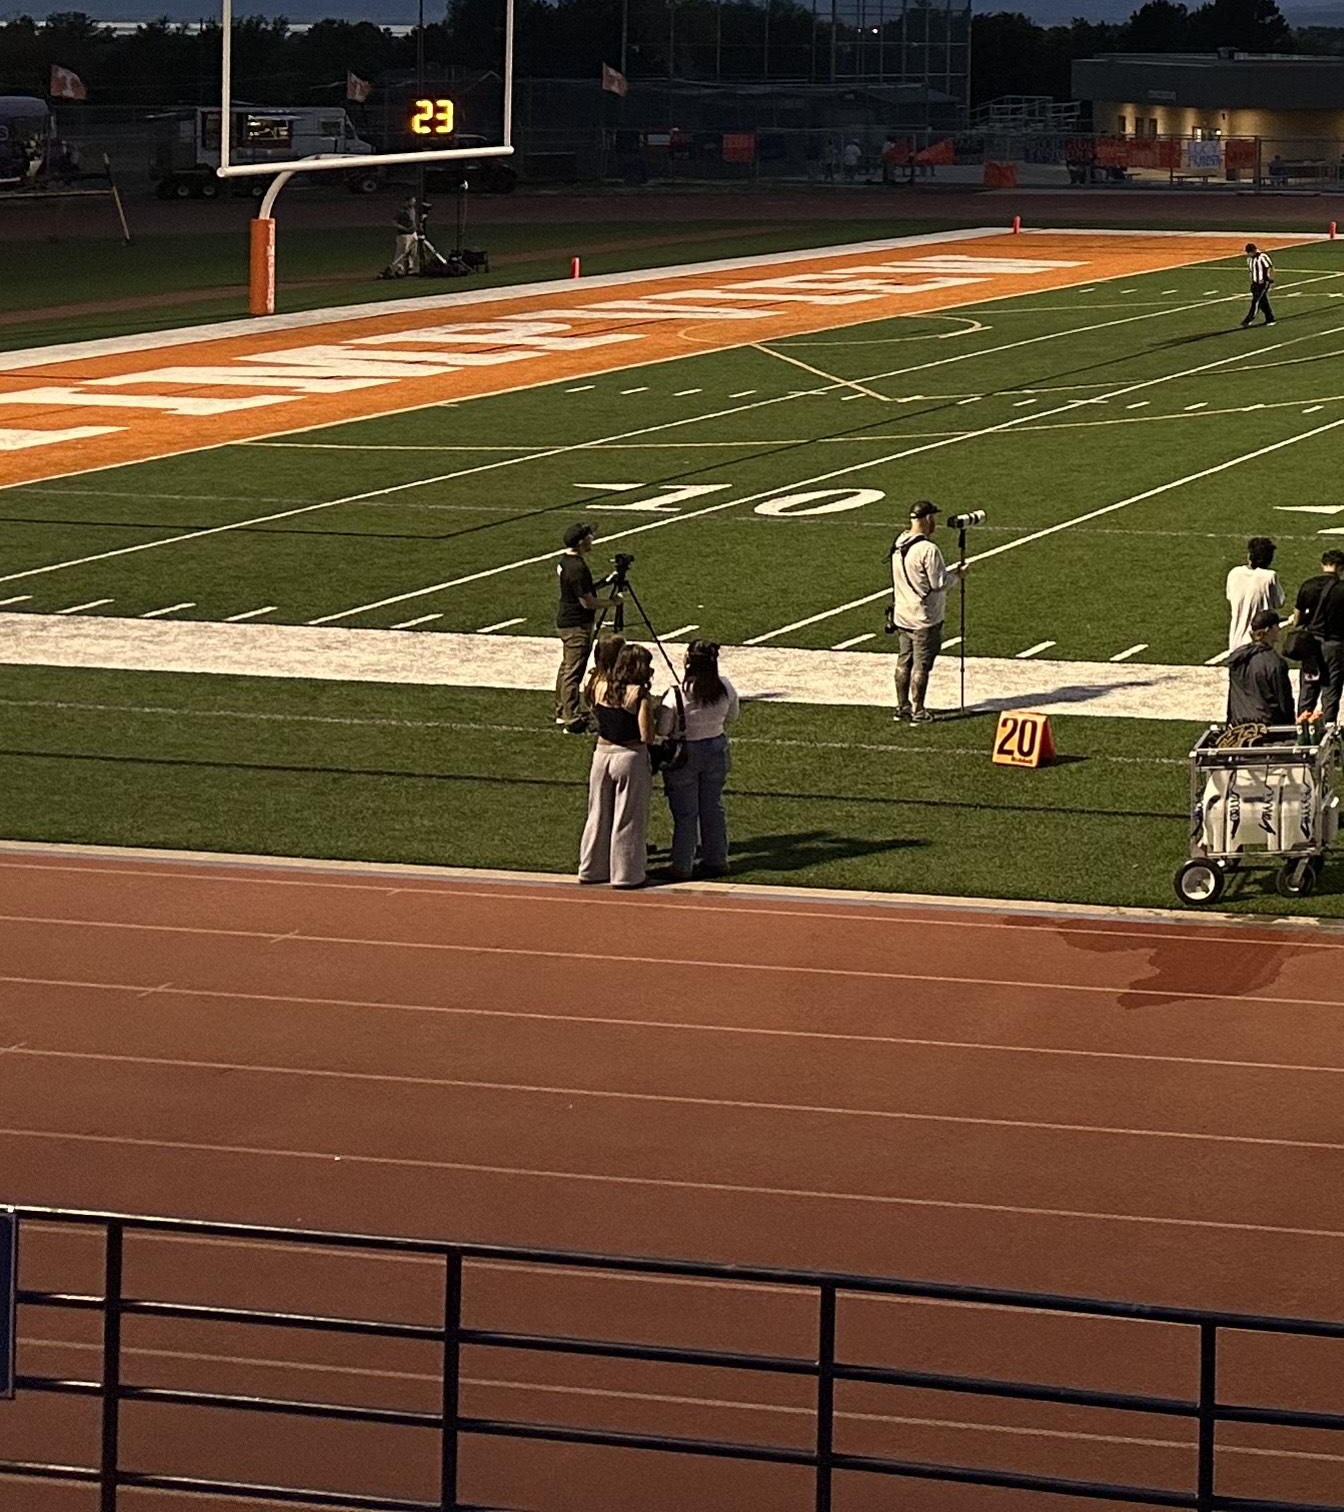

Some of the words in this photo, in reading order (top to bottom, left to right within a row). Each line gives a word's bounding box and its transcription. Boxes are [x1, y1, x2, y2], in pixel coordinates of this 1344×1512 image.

[413, 99, 454, 134] 23
[0, 255, 1091, 451] IMPVIEW
[586, 484, 886, 516] 10
[996, 717, 1038, 757] 20
